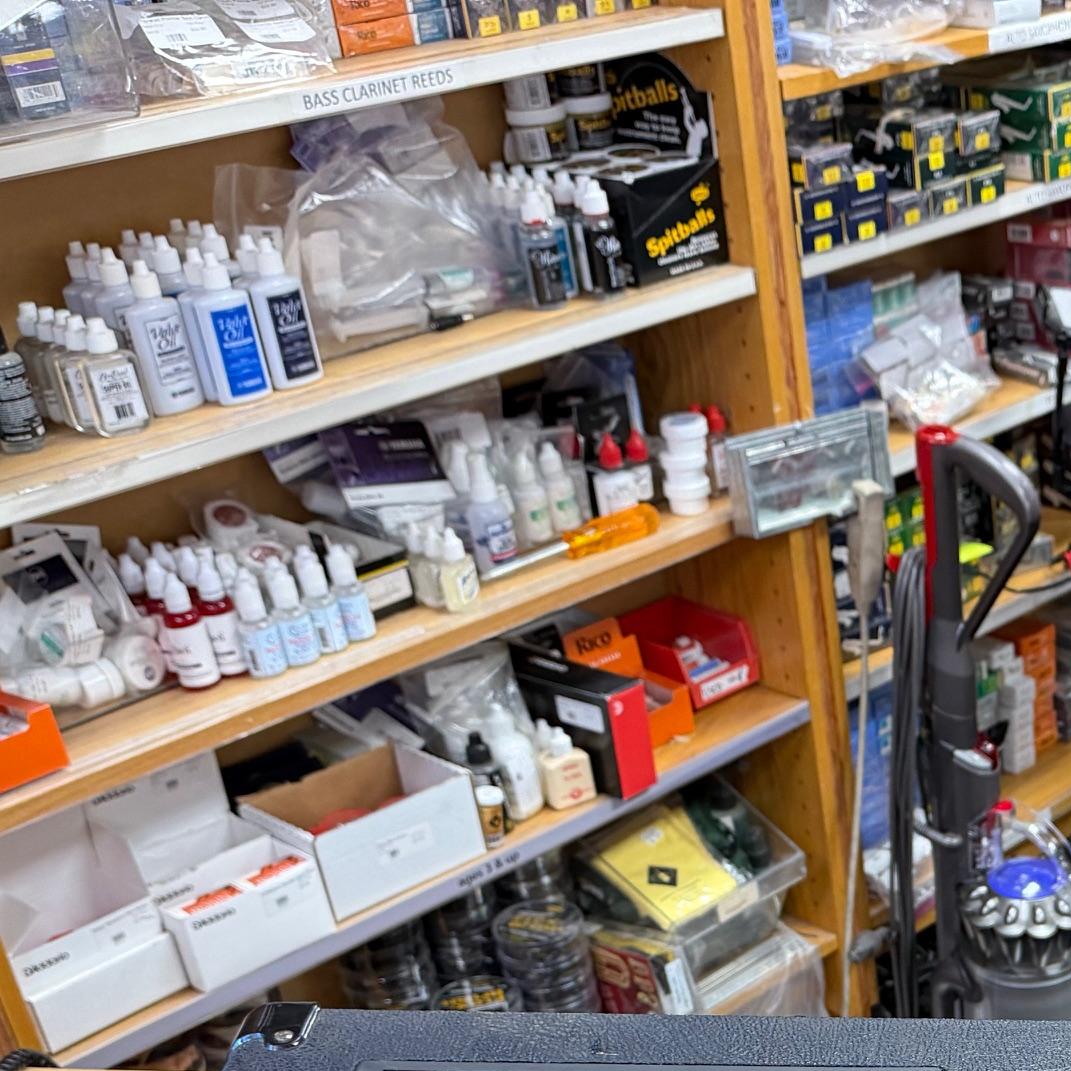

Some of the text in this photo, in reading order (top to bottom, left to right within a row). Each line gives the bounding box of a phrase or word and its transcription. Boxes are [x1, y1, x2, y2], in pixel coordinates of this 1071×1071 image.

[302, 69, 454, 110] BASS CLARINET REEDS
[611, 77, 679, 121] pitballs
[645, 207, 716, 258] Spitballs
